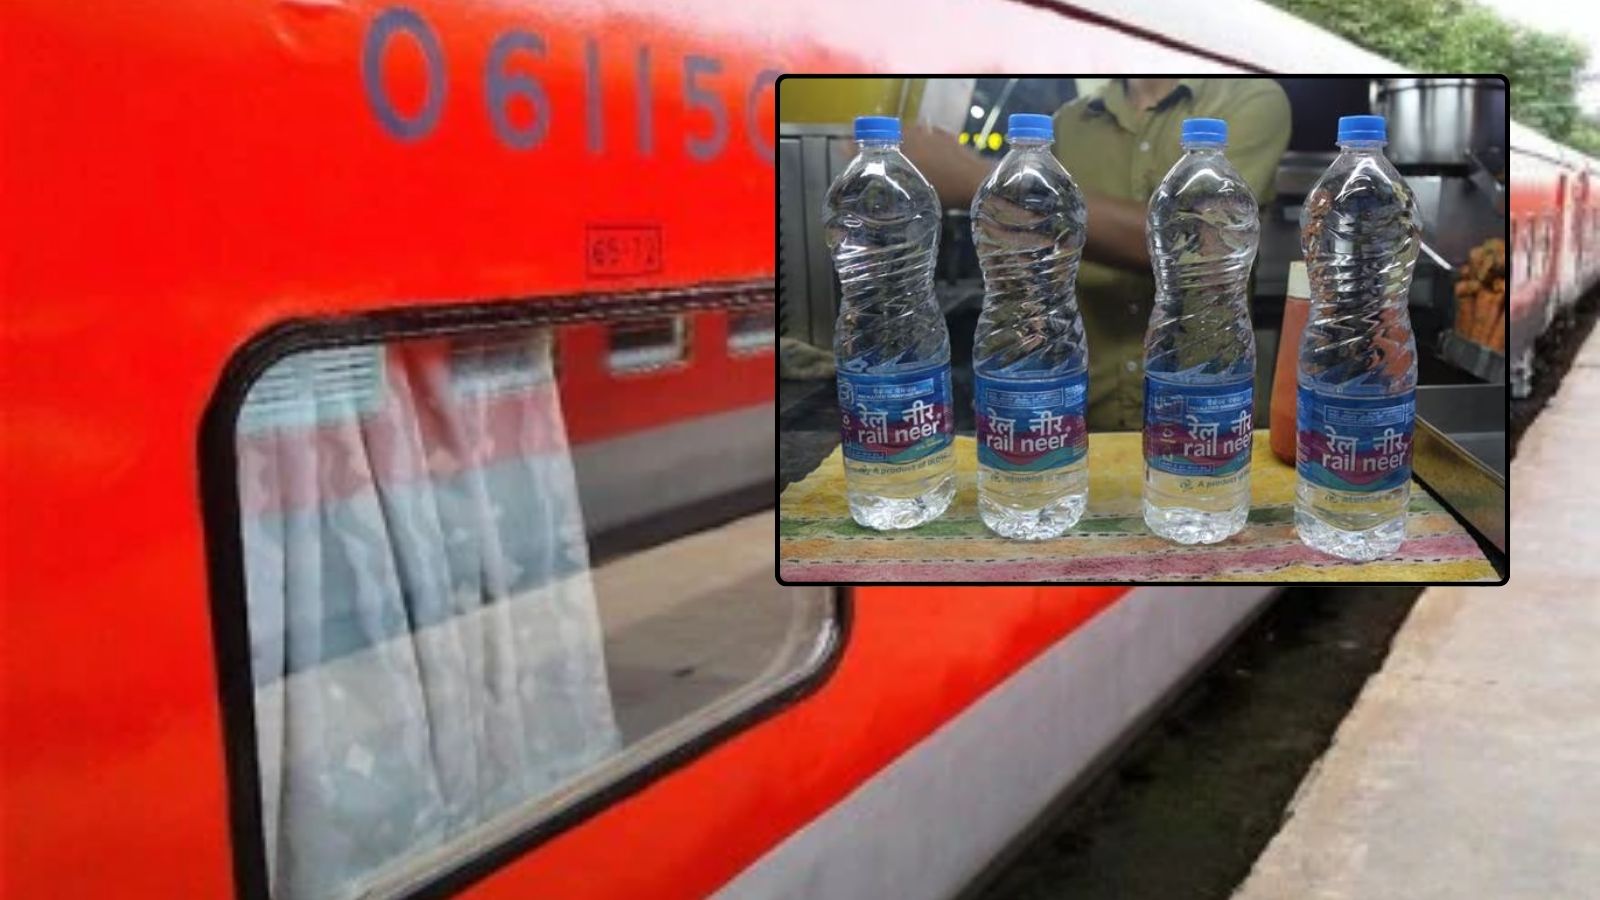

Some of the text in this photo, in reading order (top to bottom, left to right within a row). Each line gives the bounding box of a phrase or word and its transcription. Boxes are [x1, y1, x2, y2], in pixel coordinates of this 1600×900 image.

[856, 399, 935, 443] रेल नीर
[858, 420, 940, 444] rail neer
[986, 406, 1016, 452] रेल
[1028, 410, 1064, 436] नीर
[1185, 414, 1220, 456] रेल
[1230, 409, 1252, 436] नीर
[986, 433, 1069, 452] rail neer
[1183, 438, 1218, 457] rail
[1324, 425, 1359, 471] रेल
[1372, 427, 1404, 455] नीर
[1322, 452, 1356, 471] rail
[1362, 451, 1406, 471] neer
